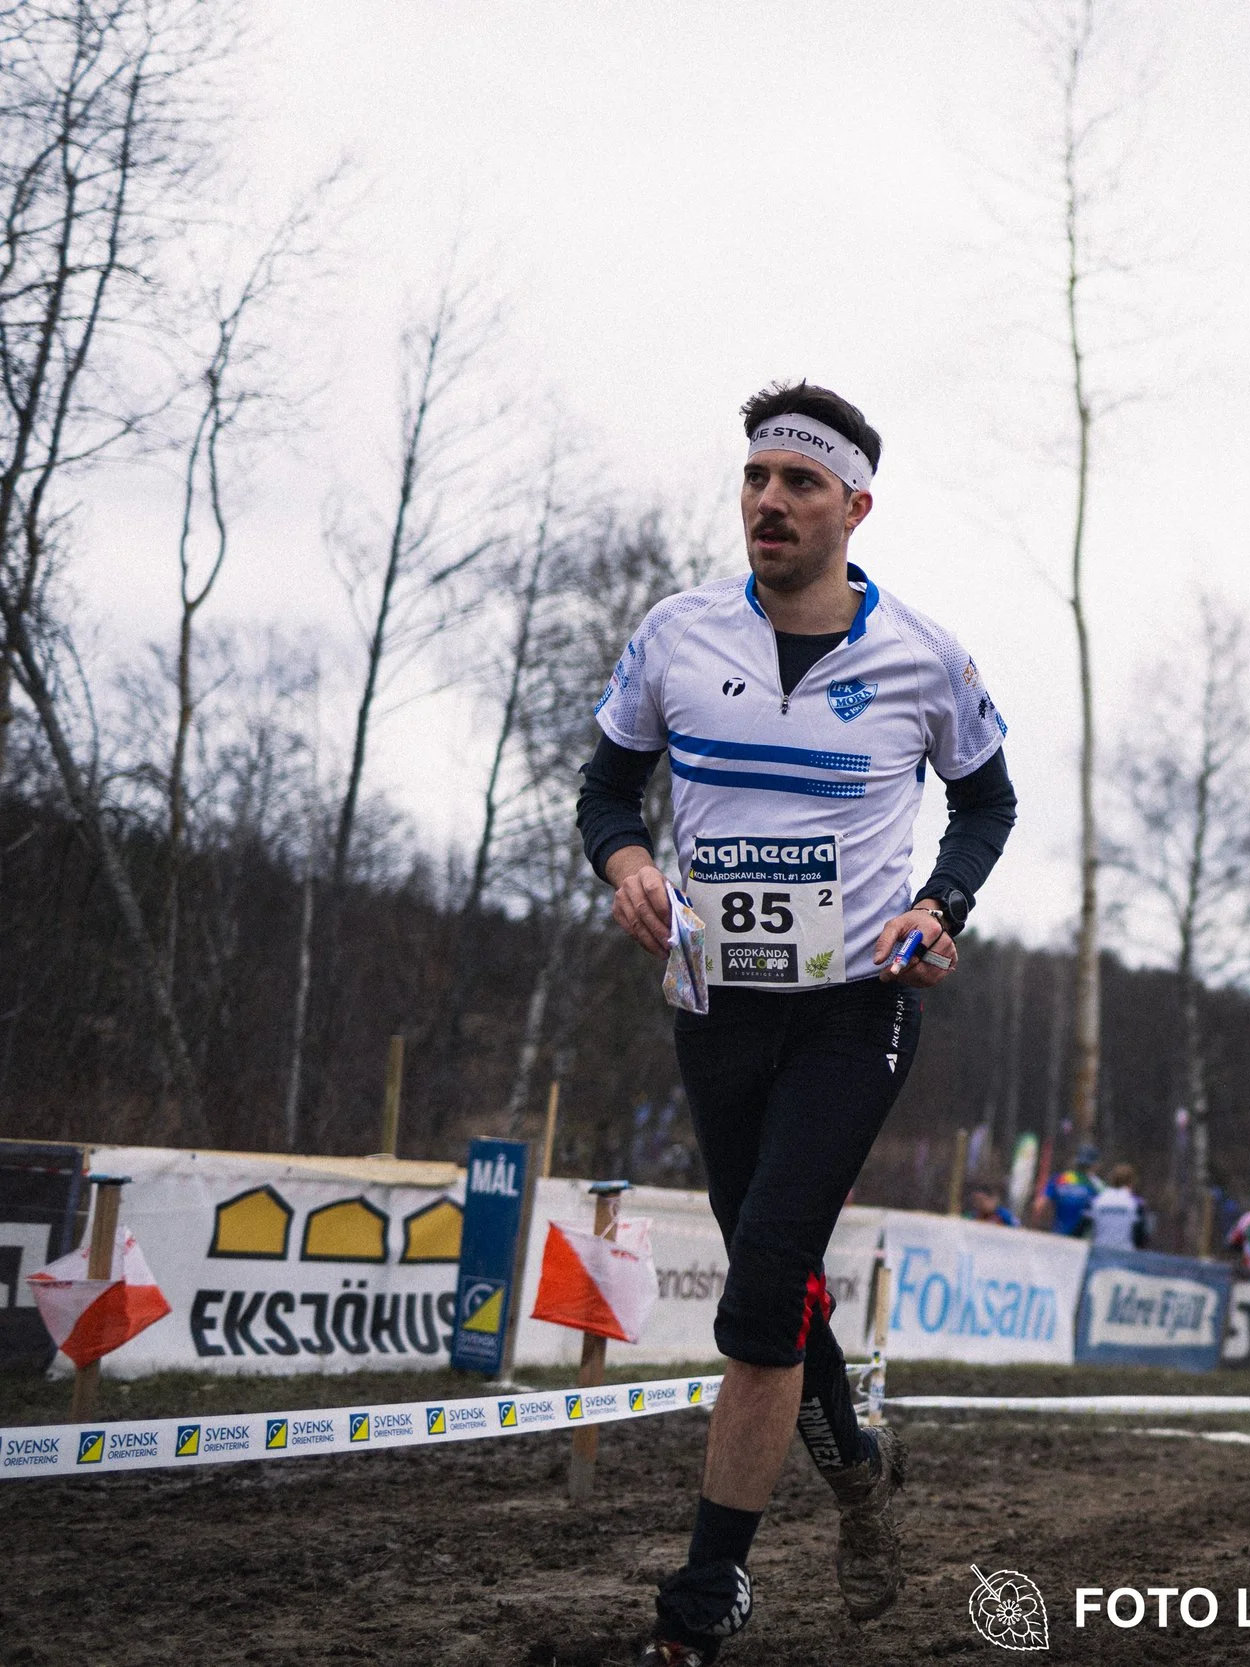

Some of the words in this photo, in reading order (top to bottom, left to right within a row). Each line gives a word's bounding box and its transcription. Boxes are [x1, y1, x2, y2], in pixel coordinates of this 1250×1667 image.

[773, 427, 835, 453] STORY
[832, 684, 853, 693] IFK
[836, 691, 871, 707] MORA
[773, 873, 787, 881] STL
[788, 873, 799, 881] #1
[801, 872, 821, 881] 2026
[721, 891, 794, 934] 85
[818, 889, 833, 907] 2
[728, 947, 789, 958] GODKÄNDA
[470, 1155, 520, 1197] MÅL
[889, 1246, 1058, 1341] Folksam
[520, 1401, 553, 1414] SVENSK
[585, 1394, 617, 1408] SVENSK
[374, 1413, 412, 1428] SVENSK
[450, 1408, 486, 1422] SVENSK
[292, 1420, 334, 1435] SVENSK
[374, 1427, 413, 1438] ORIENTERING
[450, 1420, 487, 1431] ORIENTERING
[800, 1396, 843, 1468] TRIMTEX
[110, 1432, 159, 1448] SVENSK
[205, 1426, 250, 1442] SVENSK
[292, 1432, 334, 1445] ORIENTERING
[7, 1438, 59, 1455] SVENSK
[108, 1446, 158, 1460] ORIENTERING
[204, 1440, 250, 1453] ORIENTERING
[4, 1454, 58, 1467] ORIENTERING
